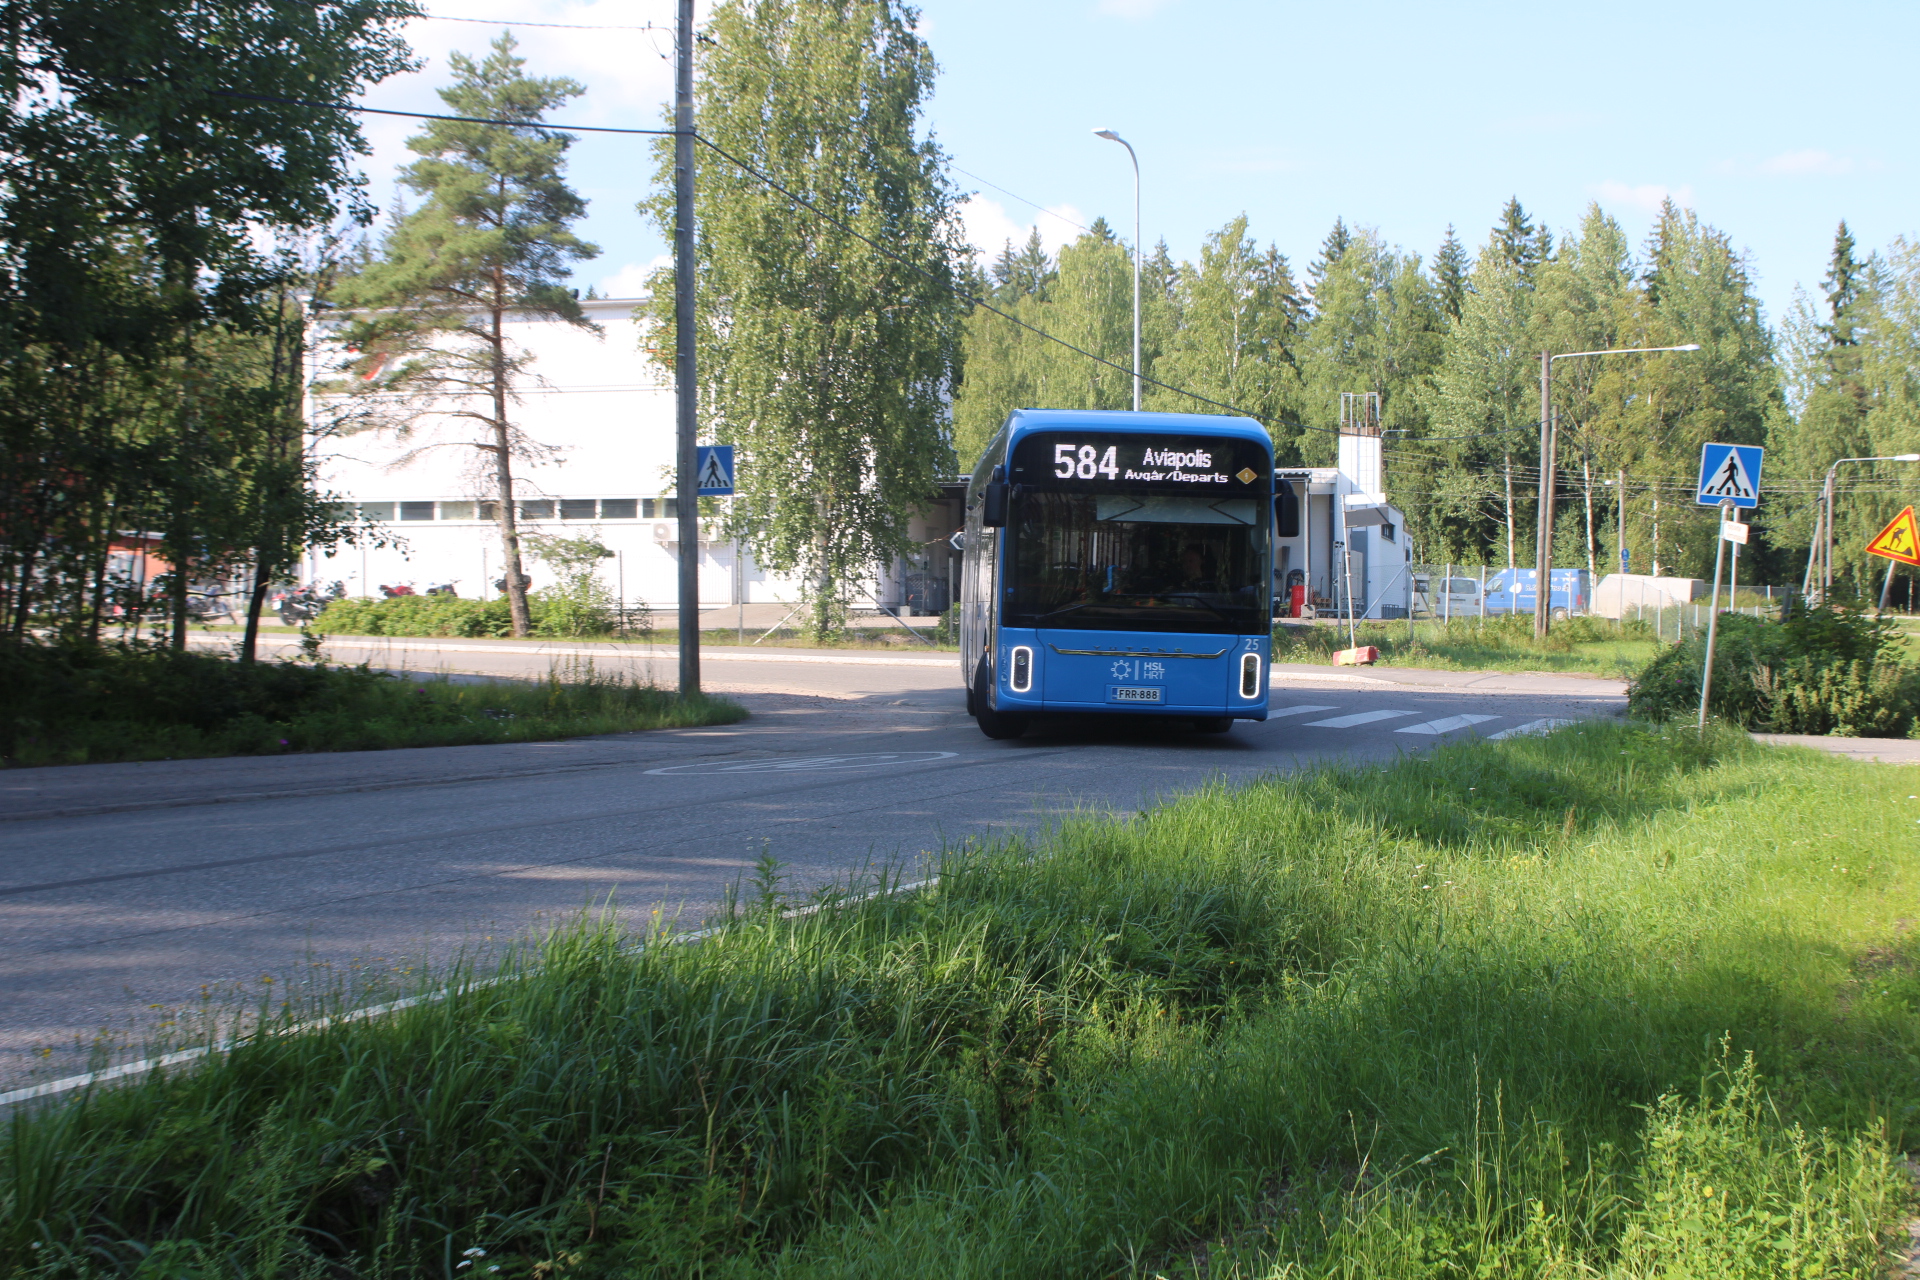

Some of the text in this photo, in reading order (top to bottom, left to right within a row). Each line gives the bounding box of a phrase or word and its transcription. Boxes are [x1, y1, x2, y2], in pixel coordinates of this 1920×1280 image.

[1055, 444, 1119, 480] 584
[1143, 447, 1212, 470] Aviapolis
[1245, 639, 1259, 650] 25
[1143, 661, 1165, 671] HSL
[1143, 671, 1165, 680] HRT
[1118, 689, 1158, 700] FRR-888
